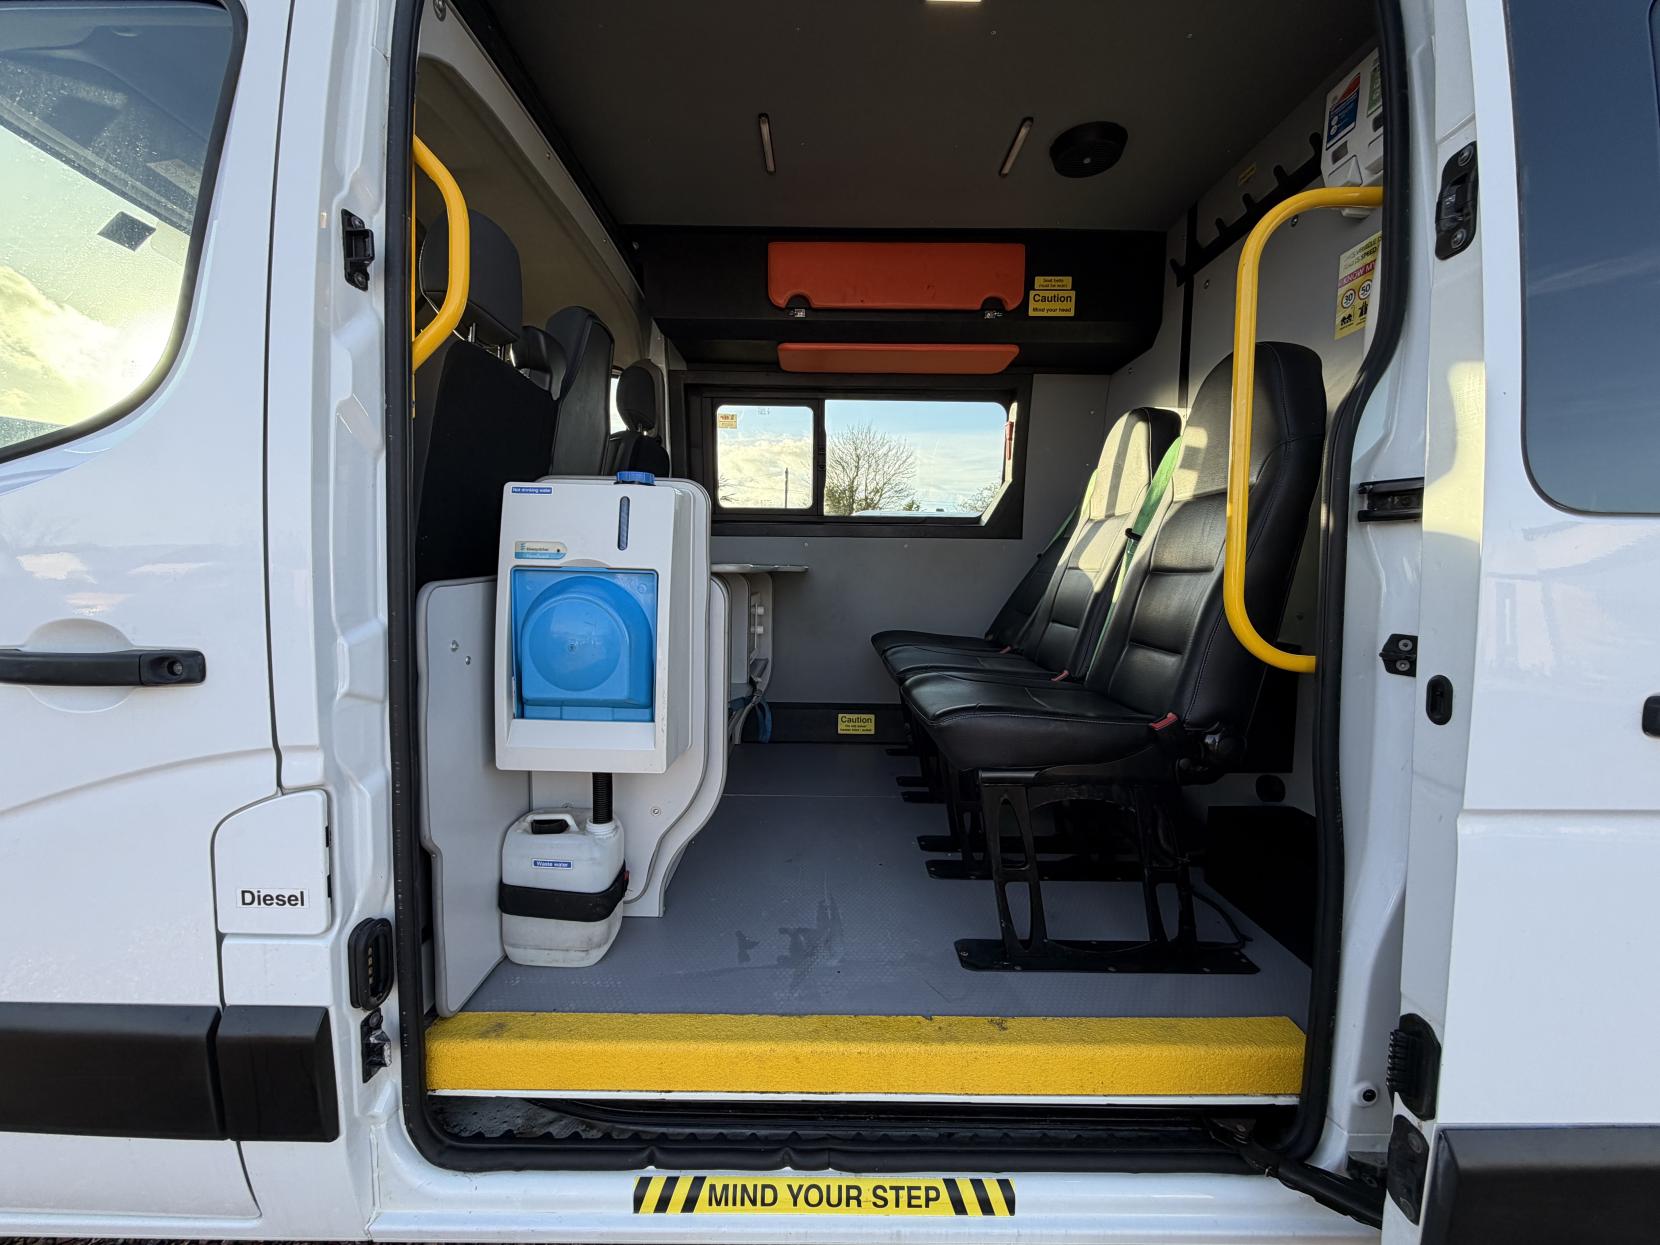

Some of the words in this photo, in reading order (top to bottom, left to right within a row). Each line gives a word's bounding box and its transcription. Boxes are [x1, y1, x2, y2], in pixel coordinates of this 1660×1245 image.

[1343, 266, 1365, 283] KNOW
[1361, 283, 1371, 294] 50
[1032, 293, 1072, 303] Caution
[1344, 293, 1353, 303] 30
[840, 715, 872, 724] Caution
[241, 889, 305, 907] Diesel
[706, 1183, 778, 1208] MIND
[787, 1184, 862, 1209] YOUR
[871, 1185, 941, 1210] STEP
